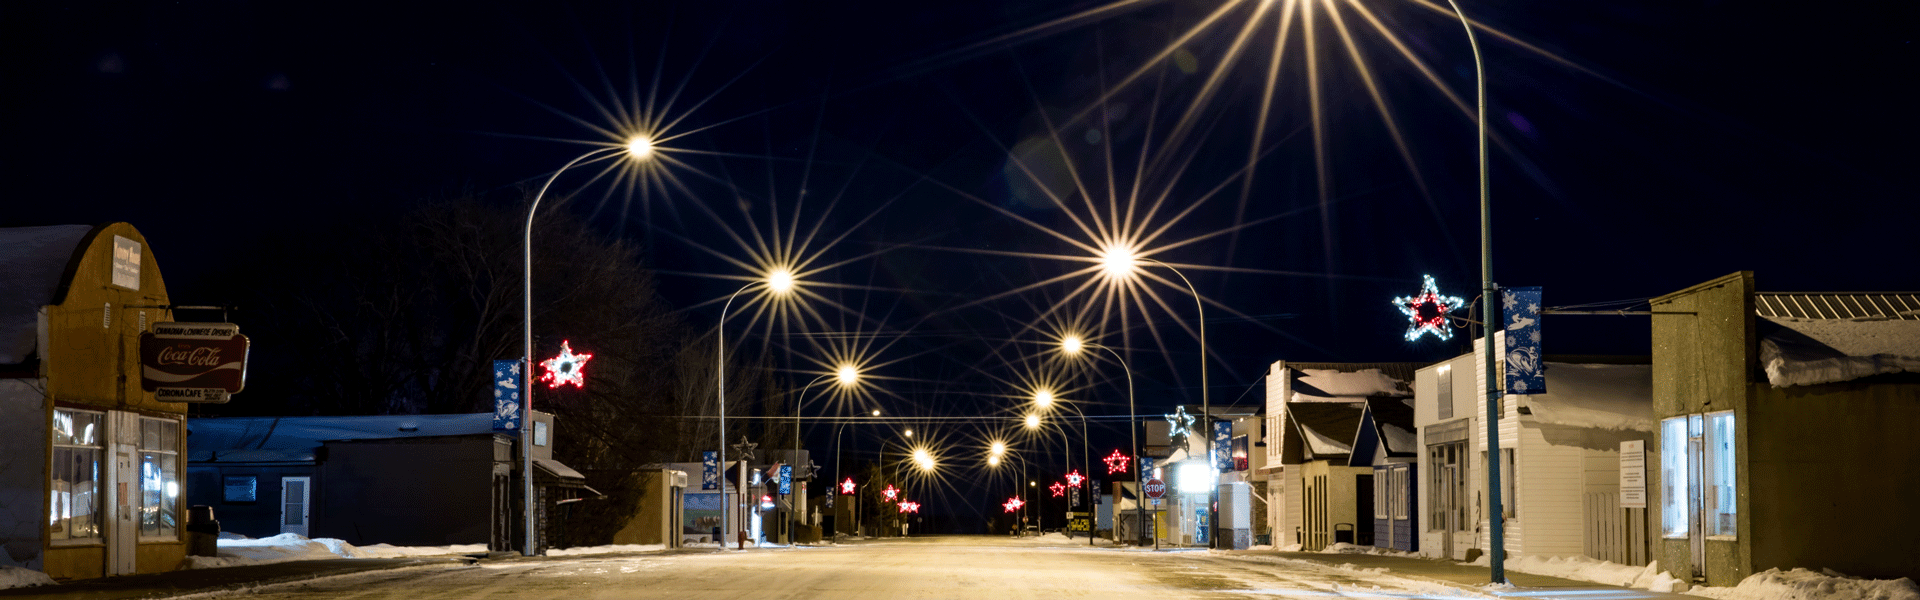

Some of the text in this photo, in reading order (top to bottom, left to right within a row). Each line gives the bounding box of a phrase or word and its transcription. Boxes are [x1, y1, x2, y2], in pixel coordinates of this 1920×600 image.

[155, 327, 183, 335] CANADIAN
[187, 327, 211, 335] CHINESE
[211, 328, 233, 336] DISHES
[158, 388, 185, 397] CORONA
[185, 388, 202, 398] CAFE
[1146, 484, 1164, 493] STOP
